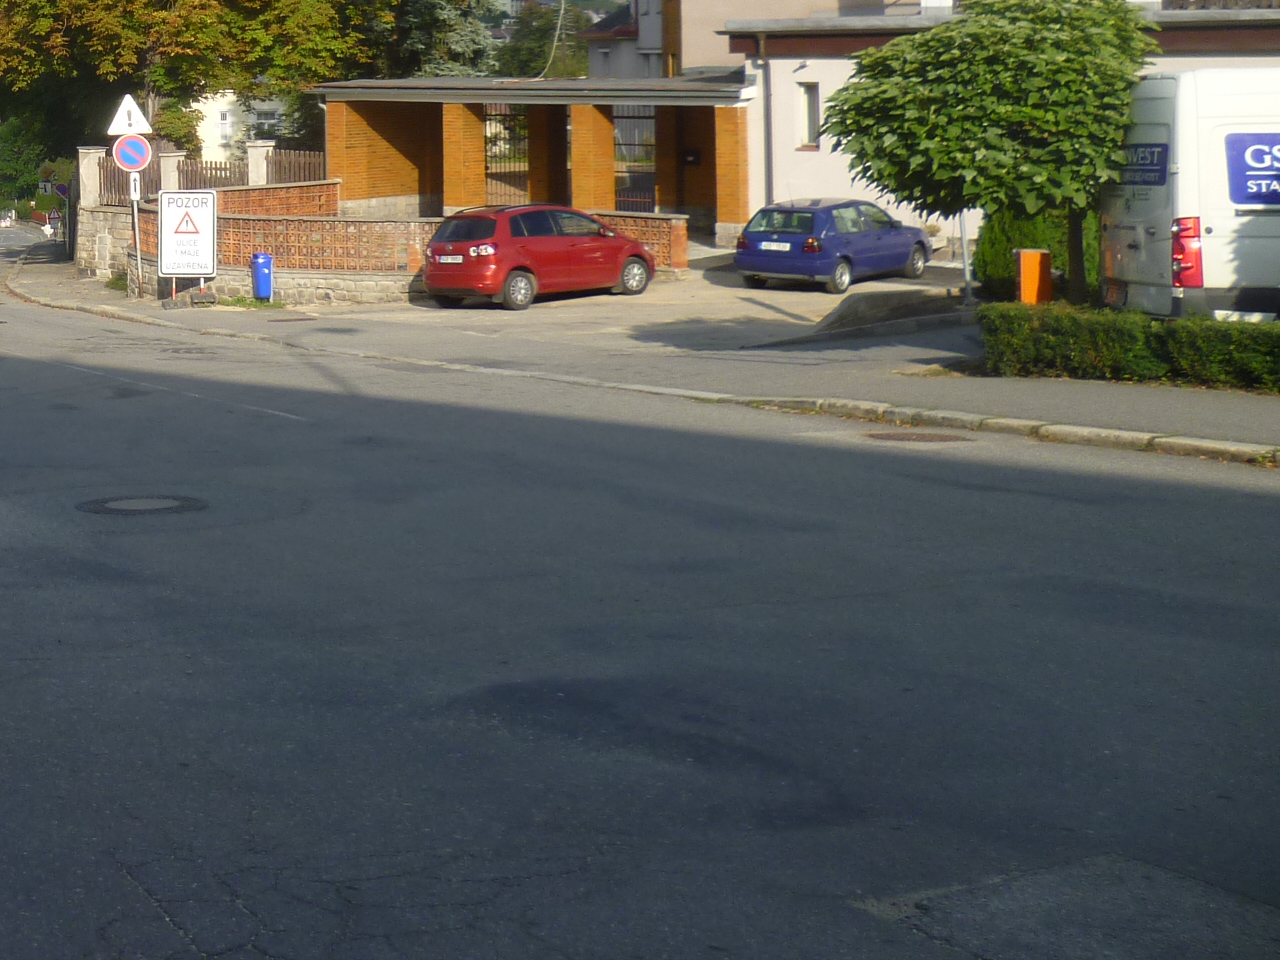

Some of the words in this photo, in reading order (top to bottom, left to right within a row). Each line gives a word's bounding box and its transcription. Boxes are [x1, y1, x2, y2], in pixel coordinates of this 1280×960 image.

[167, 197, 209, 208] POZOR
[176, 239, 199, 247] ULICE
[165, 261, 209, 270] UZAVŘENA
